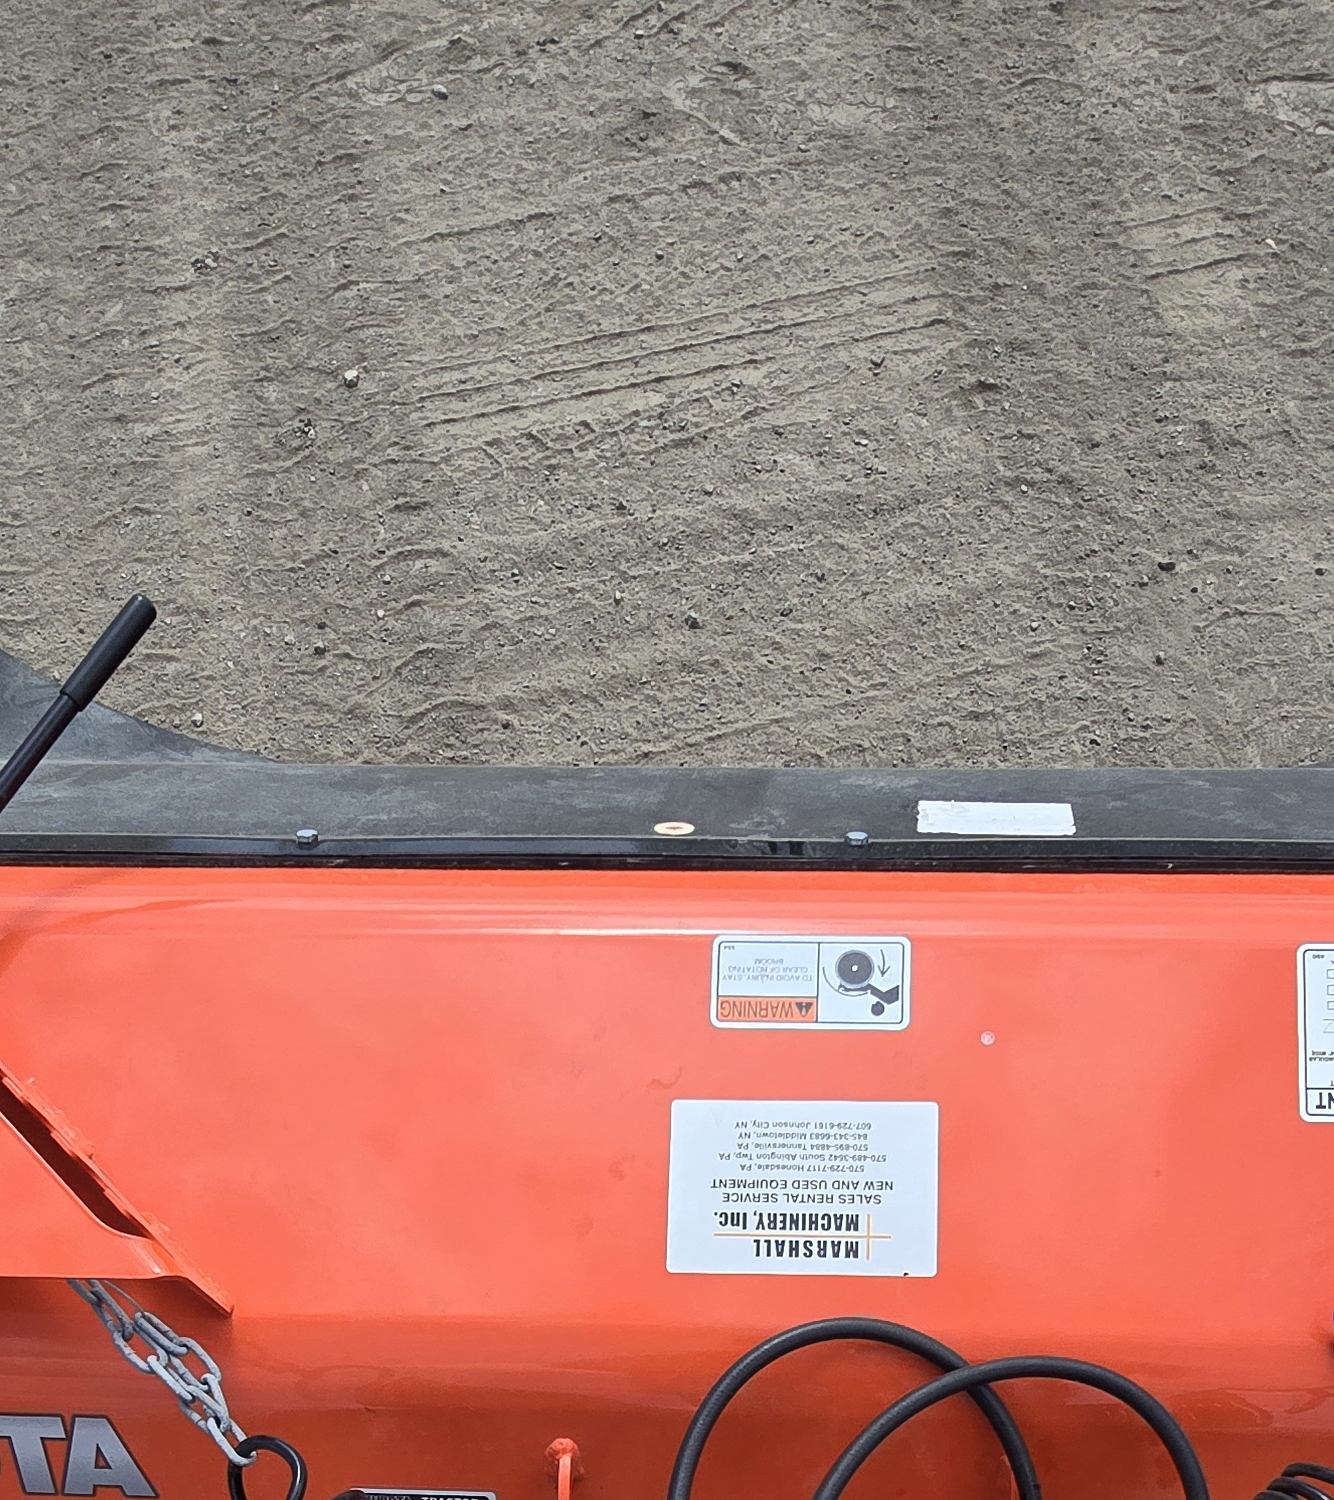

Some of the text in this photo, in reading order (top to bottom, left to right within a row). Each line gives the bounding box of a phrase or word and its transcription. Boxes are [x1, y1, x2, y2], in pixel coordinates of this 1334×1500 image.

[720, 1001, 793, 1018] WARNING
[750, 1120, 769, 1128] City,
[772, 1121, 811, 1129] Johnson
[754, 1131, 807, 1139] Middletown,
[756, 1152, 797, 1161] Abington
[754, 1163, 804, 1171] Honesdale,
[807, 1164, 864, 1172] 570-729-7117
[710, 1179, 893, 1190] NEW AND USED EQUIPMENT
[722, 1193, 882, 1204] SALES RENTAL SERVICE
[714, 1211, 859, 1231] MACHINERY, Inc.
[753, 1239, 859, 1259] MARSHALL
